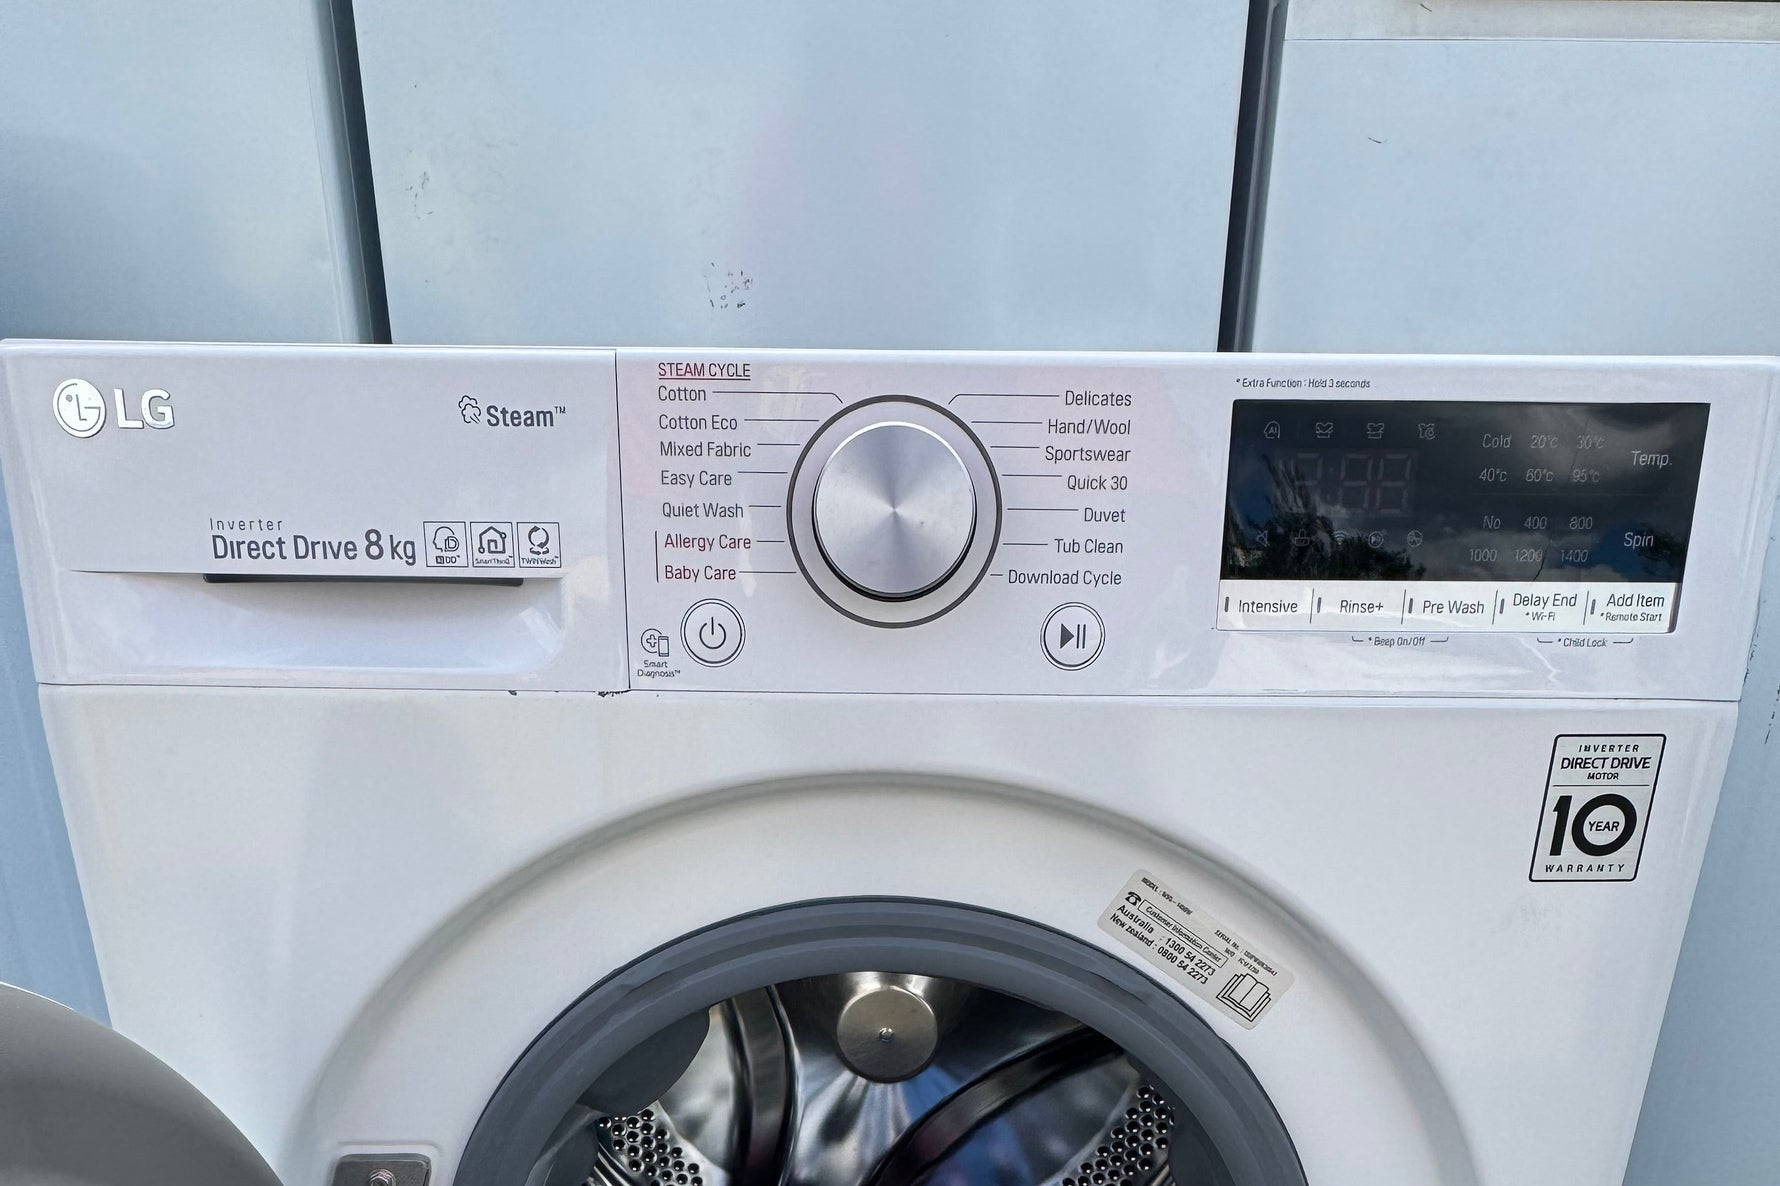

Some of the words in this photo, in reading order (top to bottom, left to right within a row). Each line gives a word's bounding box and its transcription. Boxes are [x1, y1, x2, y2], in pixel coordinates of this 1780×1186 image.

[658, 362, 705, 377] STEAM
[709, 363, 751, 378] CYCLE
[1242, 378, 1264, 388] Extra
[1266, 378, 1302, 388] Function
[1308, 379, 1327, 388] Hold
[1328, 379, 1334, 388] 3
[1335, 379, 1371, 388] seconds
[658, 385, 706, 401] Cotton
[1065, 390, 1132, 406] Delicates
[114, 388, 175, 430] LG
[659, 414, 707, 430] Cotton
[711, 415, 738, 430] Eco
[1048, 419, 1131, 435] Hand/Wool
[660, 441, 703, 457] Mixed
[707, 442, 752, 457] Fabric
[1482, 434, 1512, 449] Cold
[1045, 445, 1132, 464] Sportswear
[1631, 451, 1673, 469] Temp.
[661, 470, 695, 488] Easy
[700, 471, 732, 486] Care
[1067, 475, 1107, 490] Quick
[1110, 475, 1128, 490] 30
[662, 502, 700, 518] Quiet
[703, 503, 744, 518] Wash
[1084, 507, 1126, 522] Duvet
[209, 518, 283, 531] Inverter
[1482, 516, 1501, 530] No
[1523, 516, 1547, 530] 400
[1569, 516, 1593, 530] 800
[212, 534, 288, 560] Direct
[293, 535, 358, 560] Drive
[364, 528, 385, 560] 8
[389, 534, 417, 566] kg
[664, 534, 715, 551] Allergy
[719, 534, 752, 549] Care
[1054, 539, 1080, 553] Tub
[1084, 539, 1123, 553] Clean
[1623, 532, 1654, 549] Spin
[1469, 550, 1498, 562] 1000
[1515, 549, 1543, 562] 1200
[1560, 550, 1589, 562] 1400
[665, 565, 699, 582] Baby
[704, 565, 736, 580] Care
[1008, 569, 1079, 584] Download
[1083, 570, 1122, 588] Cycle
[1238, 600, 1298, 613] Intensive
[1340, 600, 1384, 613] Rinse+
[1422, 600, 1444, 613] Pre
[1448, 600, 1485, 614] Wash
[1513, 593, 1549, 610] Delay
[1552, 593, 1577, 607] End
[1606, 593, 1633, 607] Add
[1636, 594, 1665, 607] Item
[1605, 612, 1638, 622] Remote
[1640, 612, 1662, 622] Start
[1374, 637, 1395, 647] Beep
[1397, 637, 1426, 646] On/Off
[1563, 637, 1585, 647] Child
[1586, 637, 1608, 647] Lock
[643, 660, 668, 668] Smart
[1578, 744, 1639, 752] INVERTER
[1560, 757, 1609, 769] DIRECT
[1610, 757, 1651, 769] DRIVE
[1587, 772, 1619, 780] MOTOR
[1550, 793, 1637, 856] 10
[1588, 821, 1620, 832] YEAR
[1545, 864, 1624, 873] WARRANTY
[1117, 904, 1154, 934] Australia
[1165, 937, 1186, 955] 1300
[1184, 951, 1196, 963] 54
[1194, 959, 1216, 977] 2273
[1109, 912, 1127, 929] New
[1125, 925, 1155, 948] zealand
[1157, 946, 1177, 964] 0800
[1176, 960, 1189, 972] 54
[1186, 969, 1209, 985] 2273
